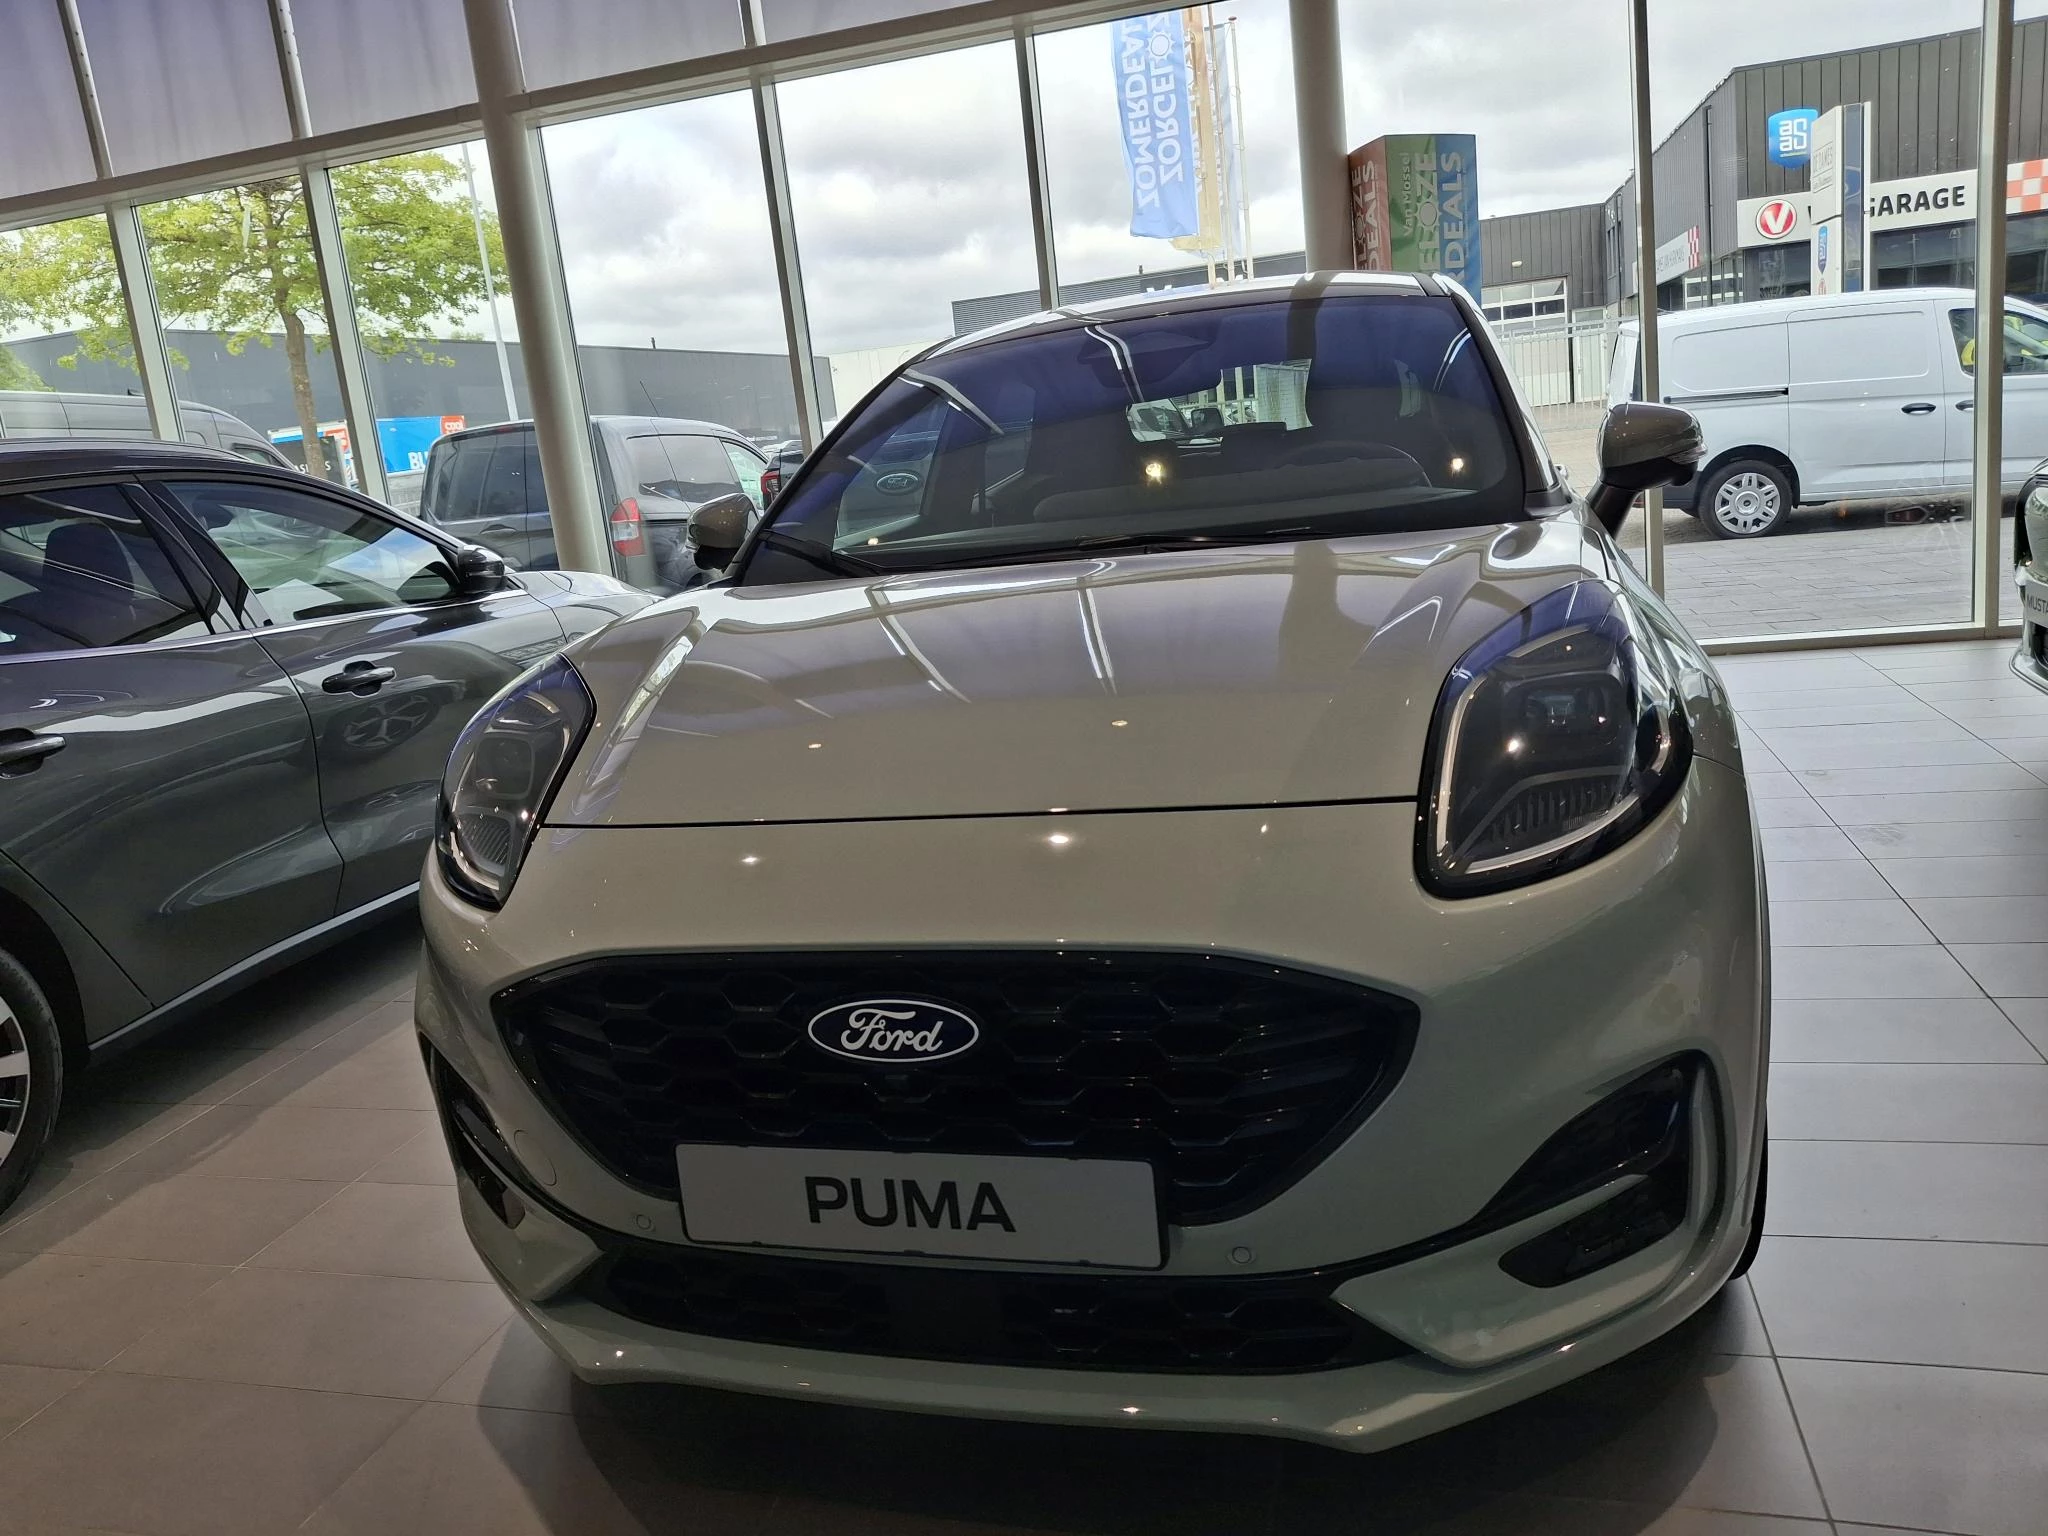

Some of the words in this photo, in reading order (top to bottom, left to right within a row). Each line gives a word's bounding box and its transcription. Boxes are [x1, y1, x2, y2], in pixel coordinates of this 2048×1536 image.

[1400, 152, 1412, 203] Mossel
[1402, 209, 1414, 237] Van
[2026, 593, 2048, 613] MUST
[841, 1008, 944, 1052] Ford
[804, 1176, 1017, 1233] PUMA
